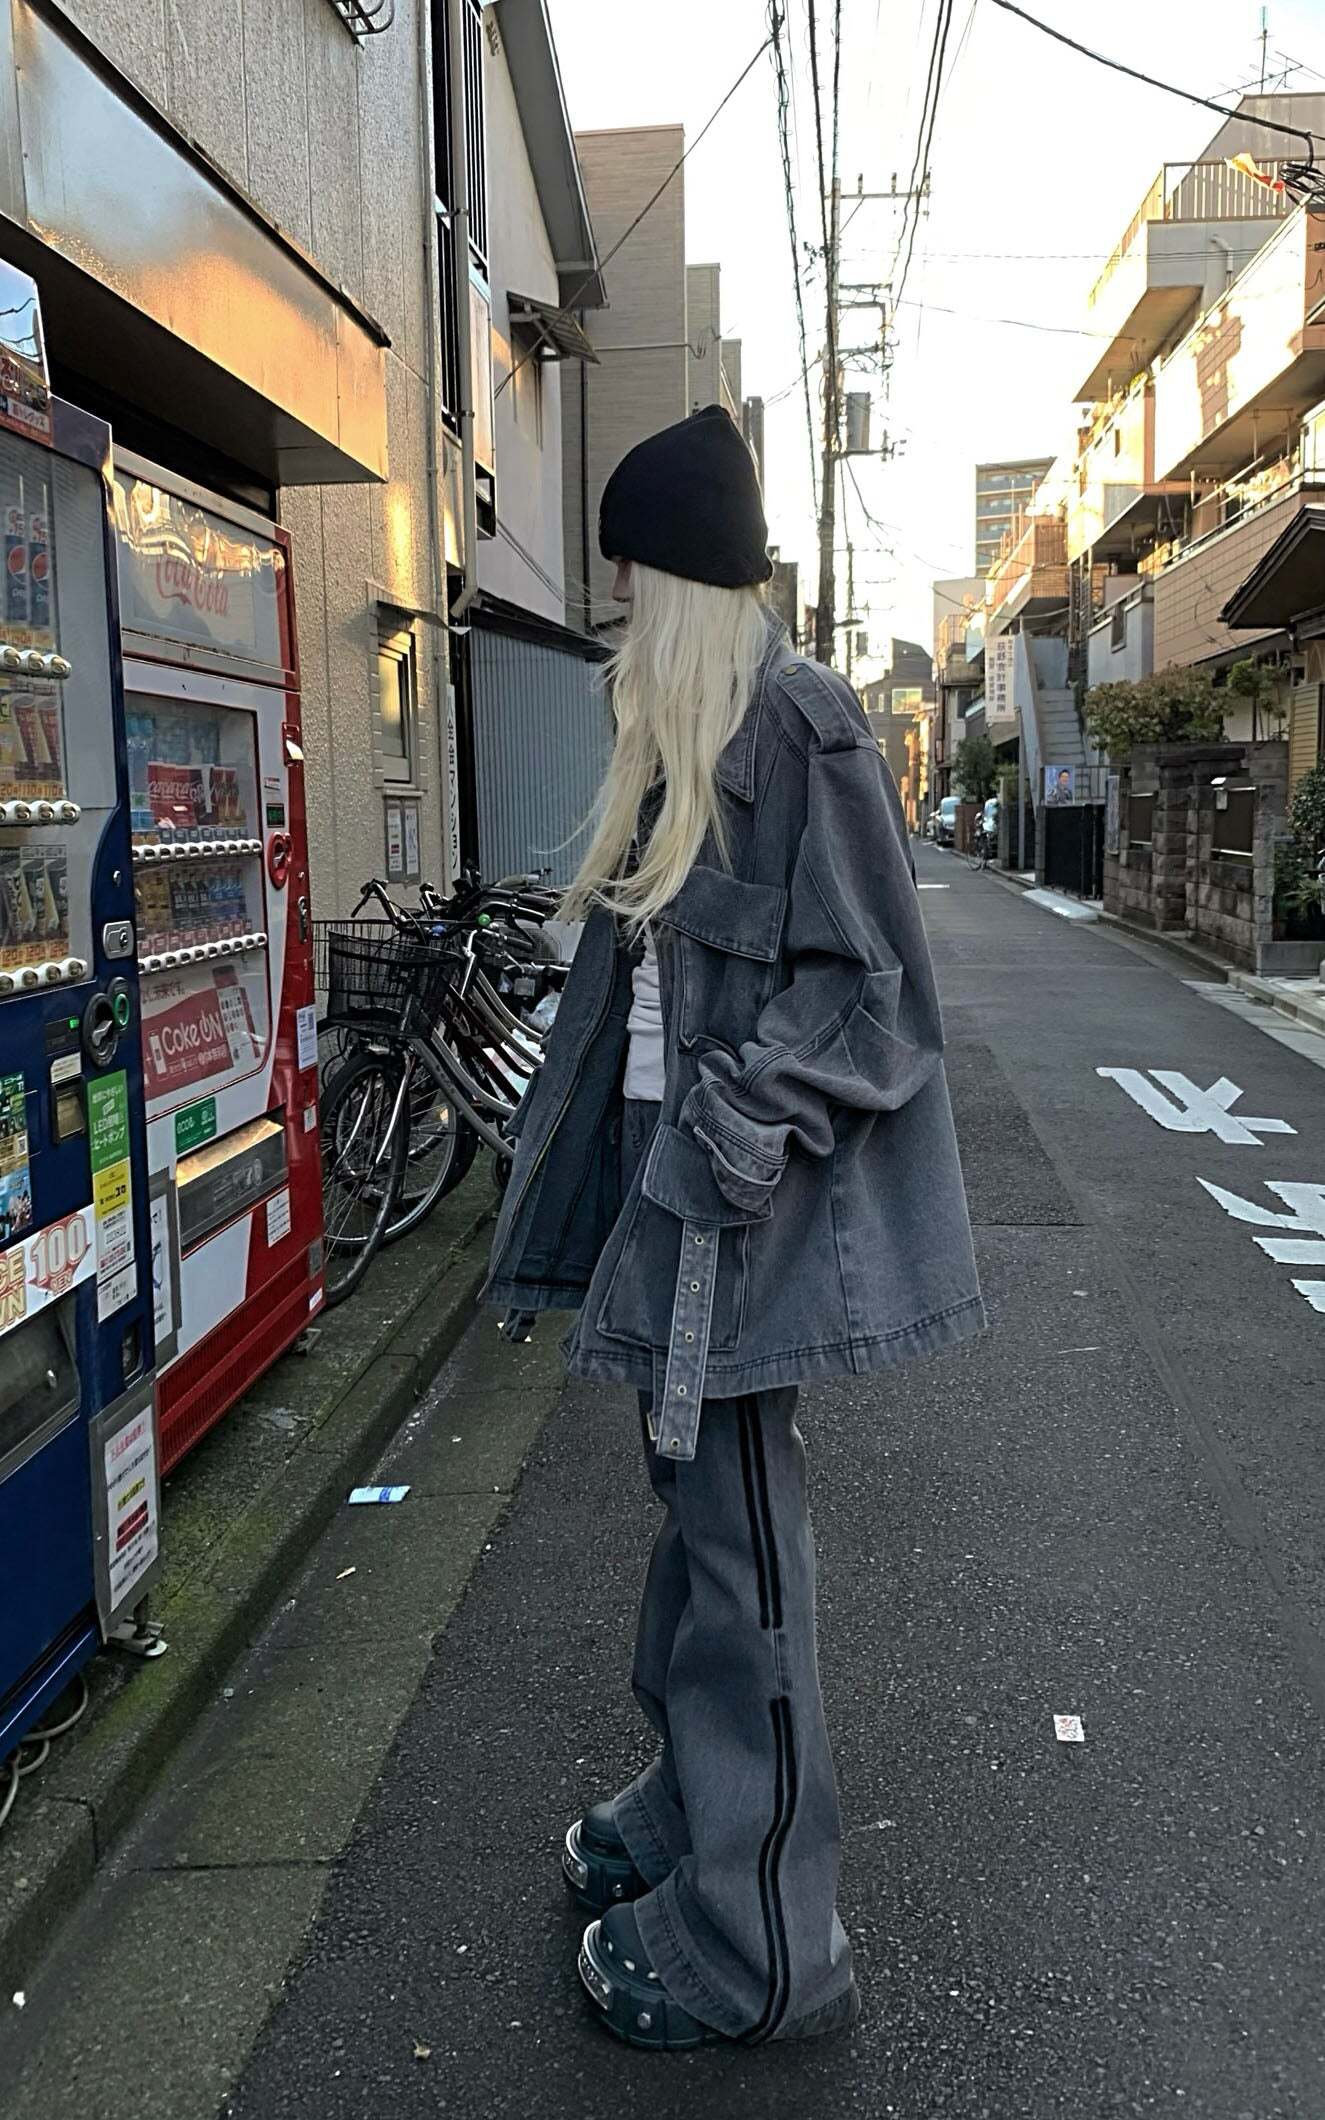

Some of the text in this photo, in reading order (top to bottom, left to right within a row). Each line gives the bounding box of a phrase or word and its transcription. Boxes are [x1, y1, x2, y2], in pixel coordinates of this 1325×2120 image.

[161, 1011, 224, 1055] Coke ON
[31, 1214, 87, 1286] 100
[51, 1269, 73, 1295] YEN
